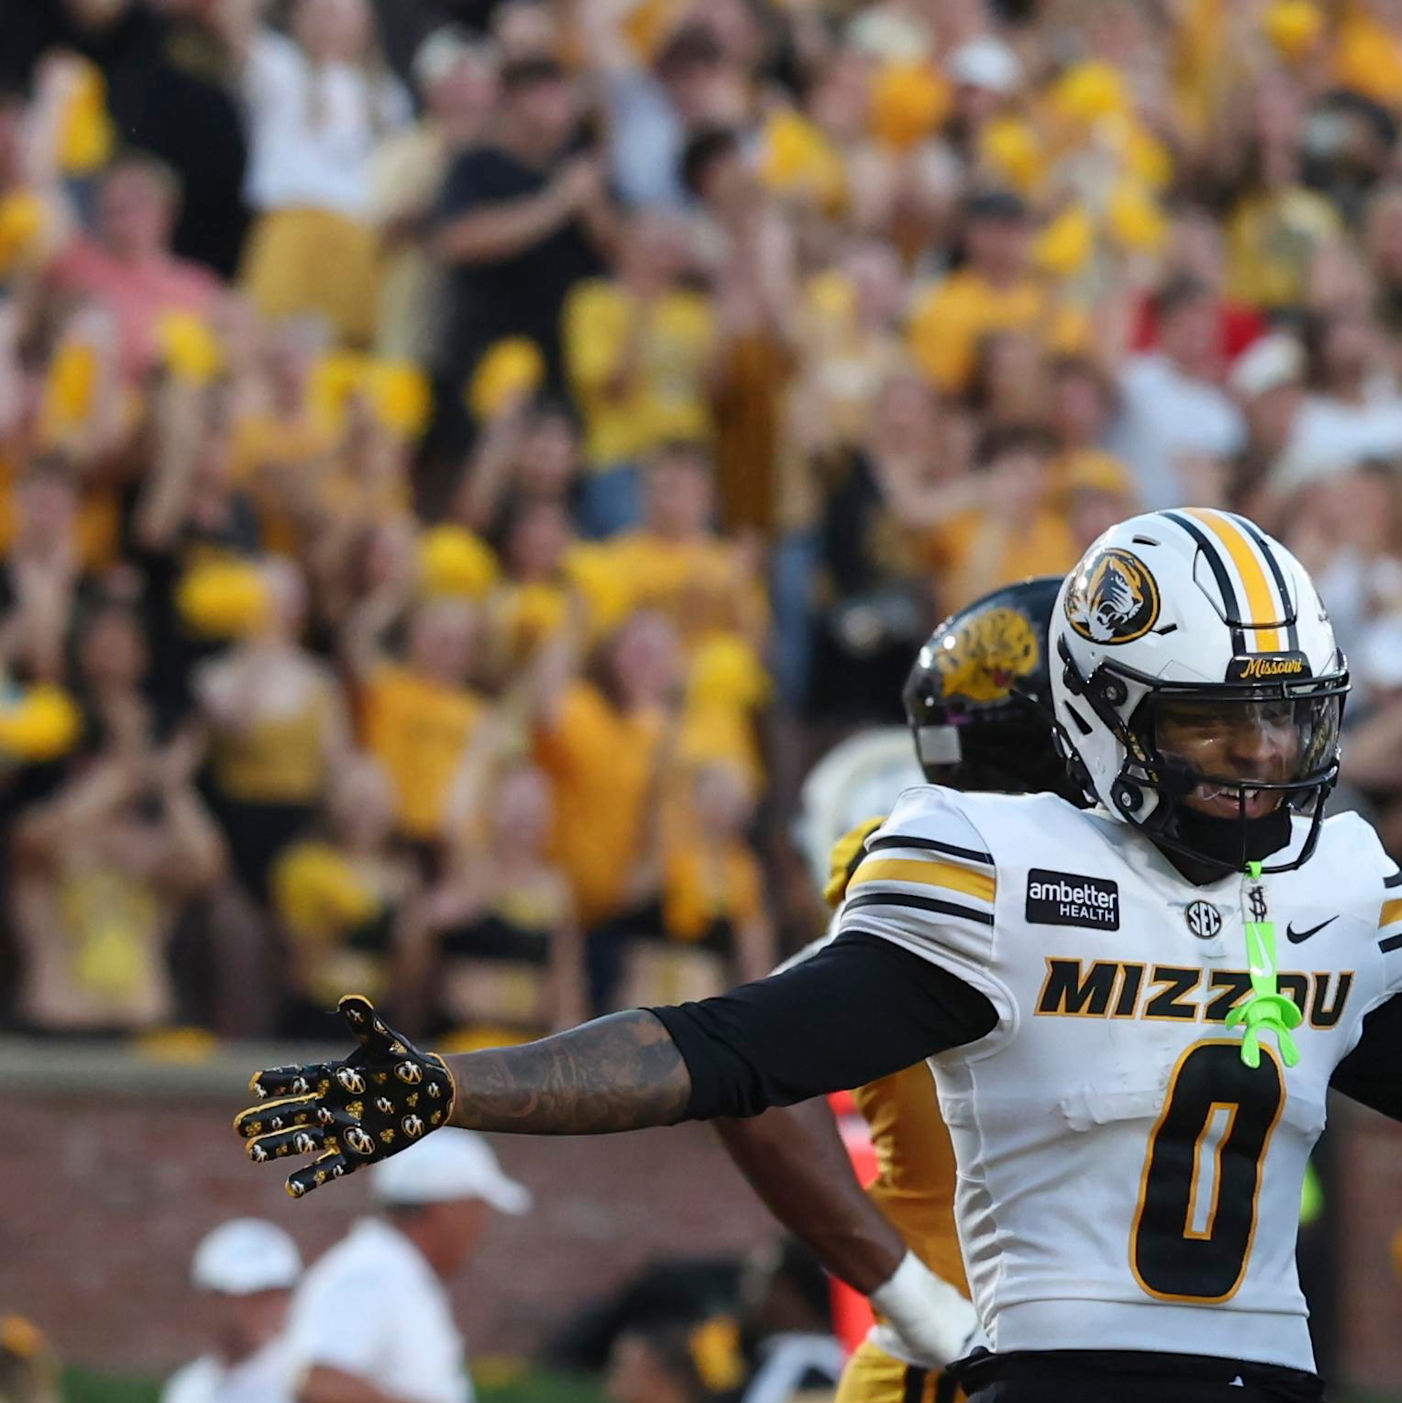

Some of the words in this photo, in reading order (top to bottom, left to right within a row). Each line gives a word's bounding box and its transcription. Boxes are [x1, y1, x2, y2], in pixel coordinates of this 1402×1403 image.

[1240, 658, 1303, 679] Missouri
[1029, 880, 1118, 910] ambetter
[1059, 903, 1116, 923] HEALTH
[1189, 902, 1221, 937] SEC
[1129, 1039, 1286, 1304] 0
